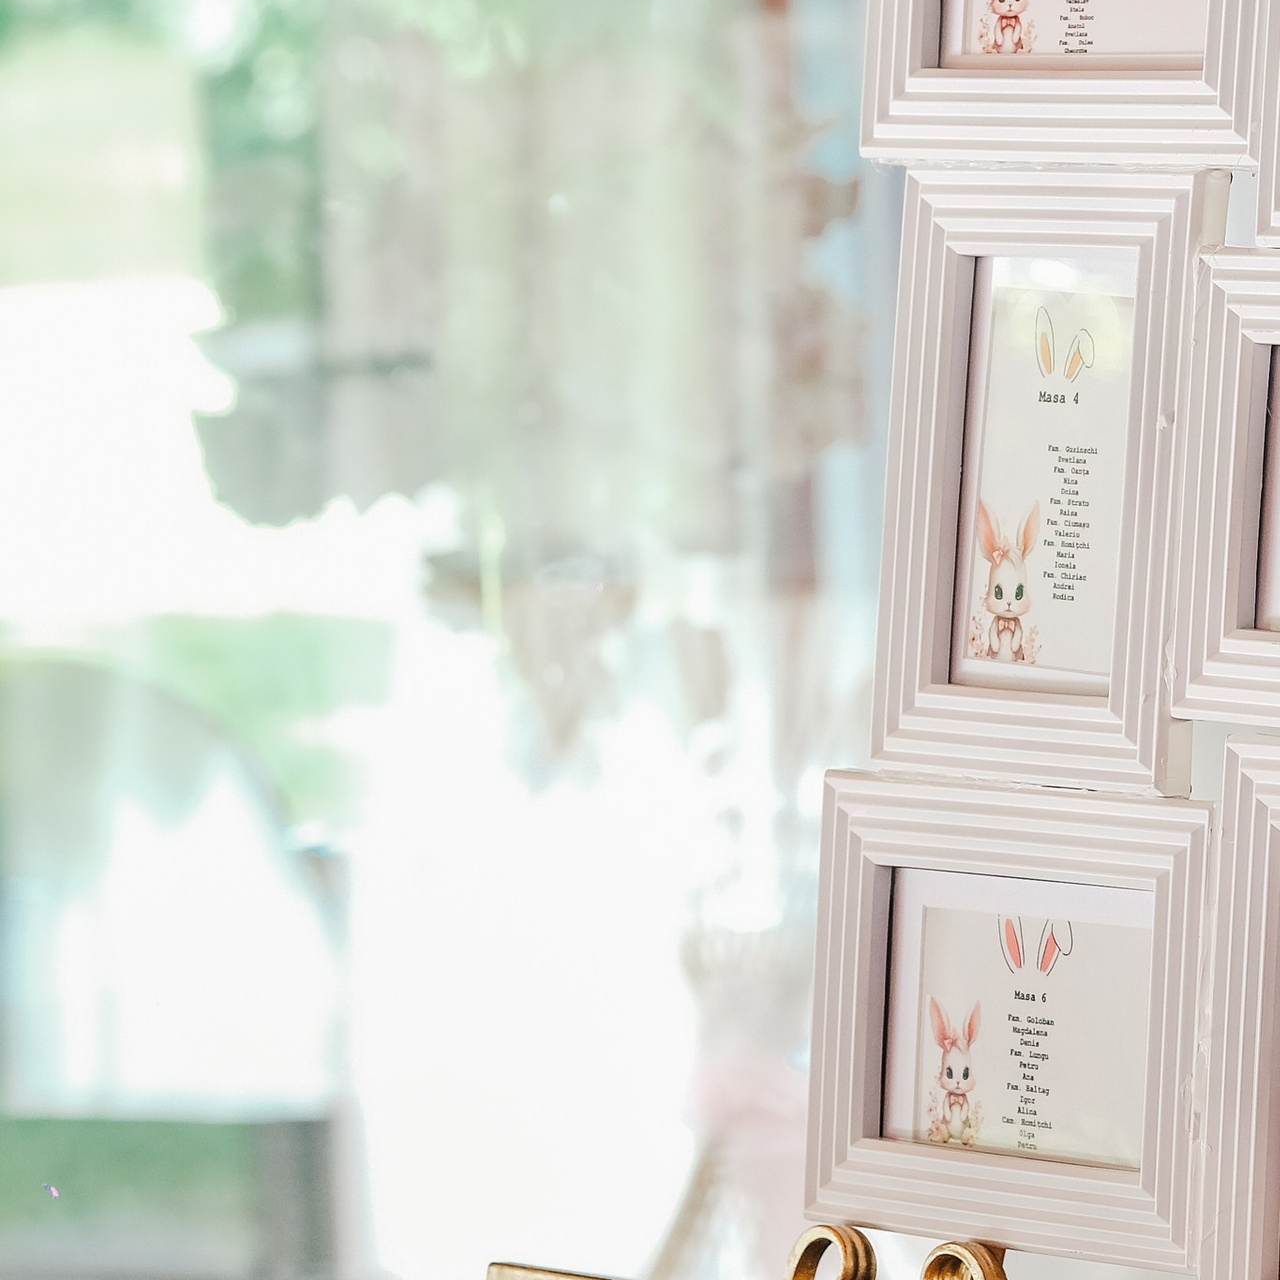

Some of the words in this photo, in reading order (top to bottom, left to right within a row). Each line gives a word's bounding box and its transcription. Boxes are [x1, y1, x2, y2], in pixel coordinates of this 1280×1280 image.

[1038, 390, 1066, 404] Masa
[1072, 391, 1079, 405] 4
[1013, 990, 1036, 1002] Masa
[1041, 992, 1047, 1003] 6
